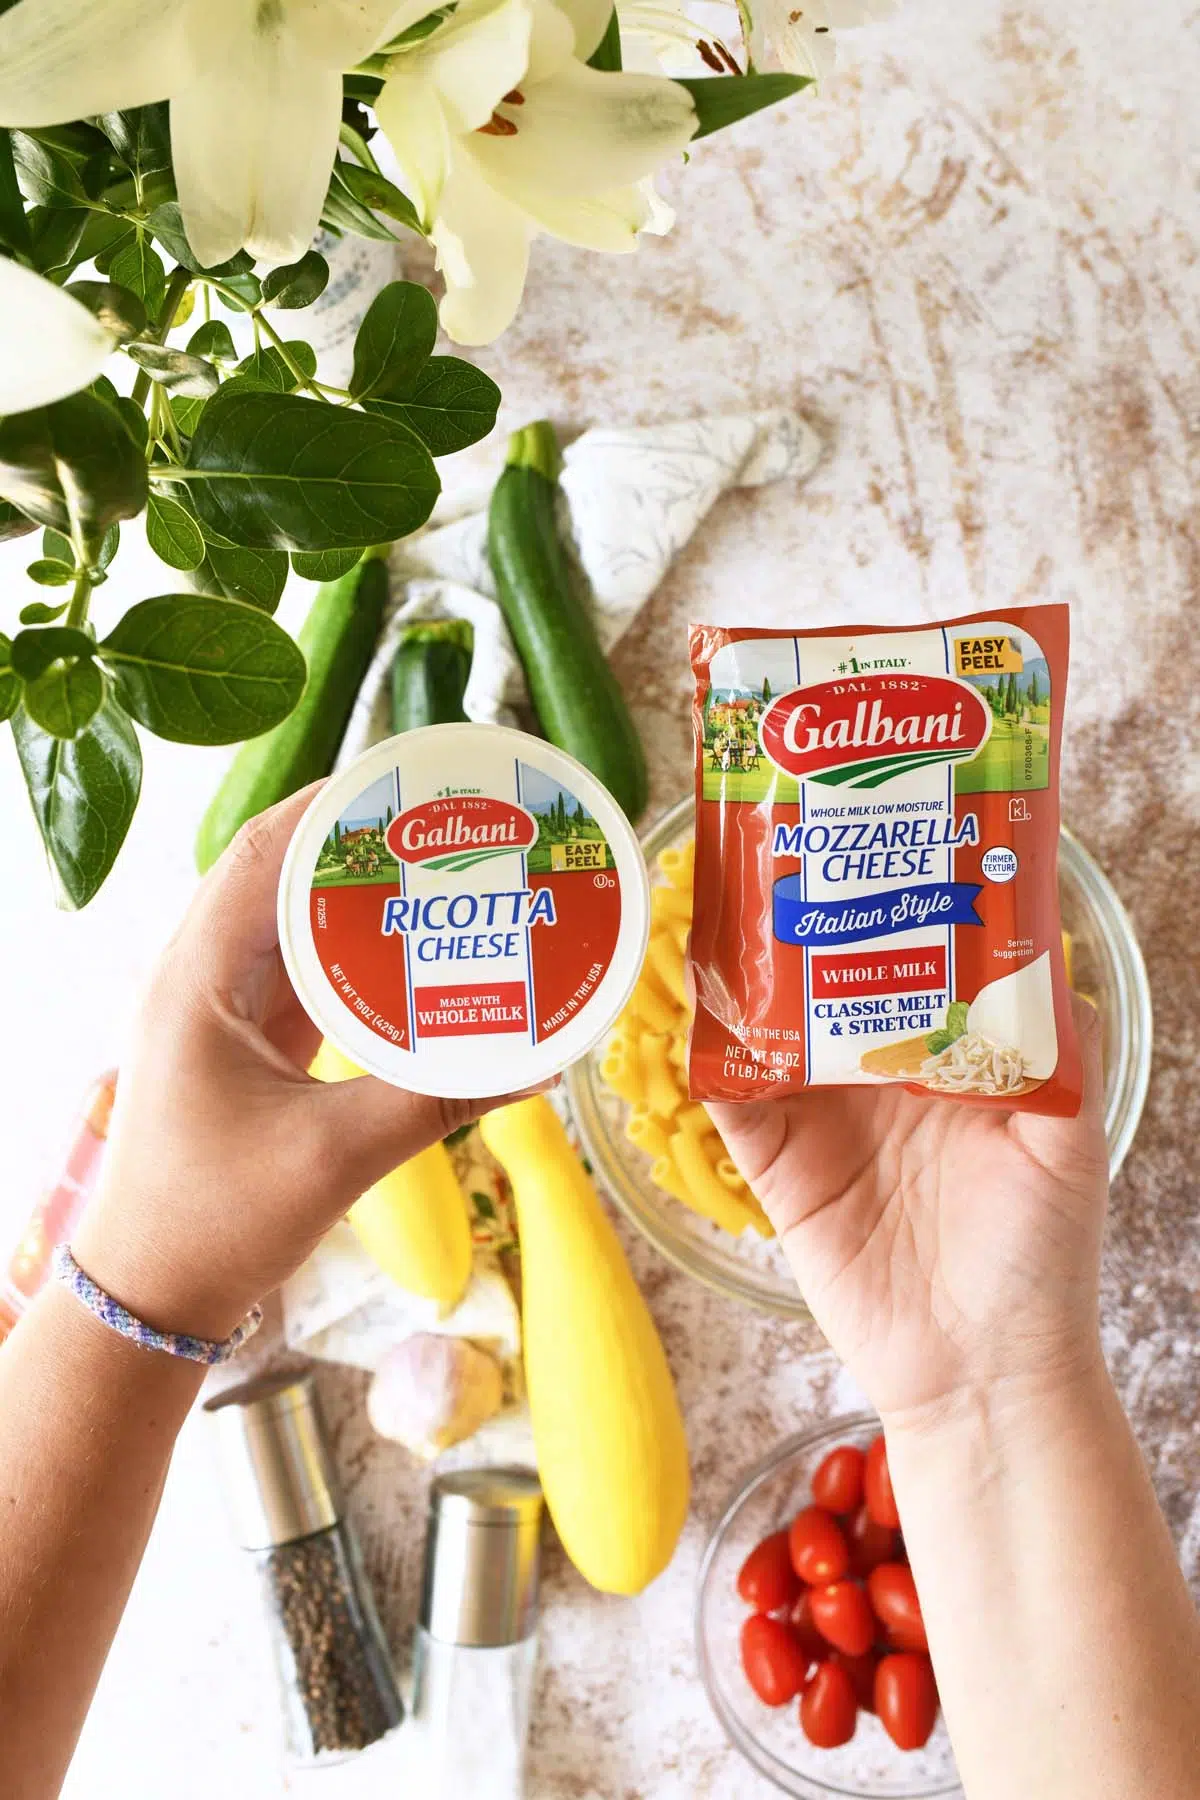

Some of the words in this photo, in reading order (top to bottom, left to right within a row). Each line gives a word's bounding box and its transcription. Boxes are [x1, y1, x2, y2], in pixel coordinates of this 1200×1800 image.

[960, 639, 1005, 656] EASY
[861, 662, 871, 670] IN
[873, 658, 907, 669] ITALY
[960, 656, 1004, 671] PEEL
[782, 699, 966, 754] Galbani
[810, 807, 846, 818] WHOLE
[847, 805, 871, 817] MILK
[872, 804, 895, 815] LOW
[896, 801, 944, 813] MOISTURE
[401, 815, 520, 851] Galbani
[774, 815, 977, 854] MOZZARELLA
[565, 843, 602, 856] EASY
[985, 854, 1014, 864] FIRMER
[566, 856, 601, 867] PEEL
[822, 848, 936, 882] CHEESE
[983, 863, 1016, 873] TEXTURE
[317, 897, 328, 929] 0732557
[384, 890, 556, 933] RICOTTA
[795, 905, 887, 937] Italian
[890, 891, 954, 928] Style
[417, 932, 520, 962] CHEESE
[993, 947, 1034, 959] Suggestion
[1007, 938, 1034, 949] Serving
[821, 965, 889, 985] WHOLE
[892, 961, 937, 978] MILK
[330, 963, 347, 985] NET
[341, 982, 358, 999] WT
[372, 1014, 405, 1042] (425g)
[439, 996, 471, 1008] MADE
[471, 995, 501, 1006] WITH
[542, 1007, 570, 1032] MADE
[565, 998, 579, 1012] IN
[574, 980, 593, 1000] THE
[586, 962, 604, 983] USA
[813, 998, 893, 1019] CLASSIC
[896, 994, 947, 1012] MELT
[417, 1008, 479, 1026] WHOLE
[480, 1006, 524, 1022] MILK
[829, 1021, 843, 1037] &
[849, 1013, 933, 1035] STRETCH
[752, 1027, 762, 1038] IN
[763, 1028, 781, 1040] THE
[782, 1029, 801, 1041] USA
[725, 1044, 748, 1060] NET
[749, 1047, 767, 1064] WT
[769, 1050, 783, 1066] 16
[785, 1051, 800, 1068] OZ
[723, 1060, 736, 1078] (1
[737, 1062, 759, 1081] LB)
